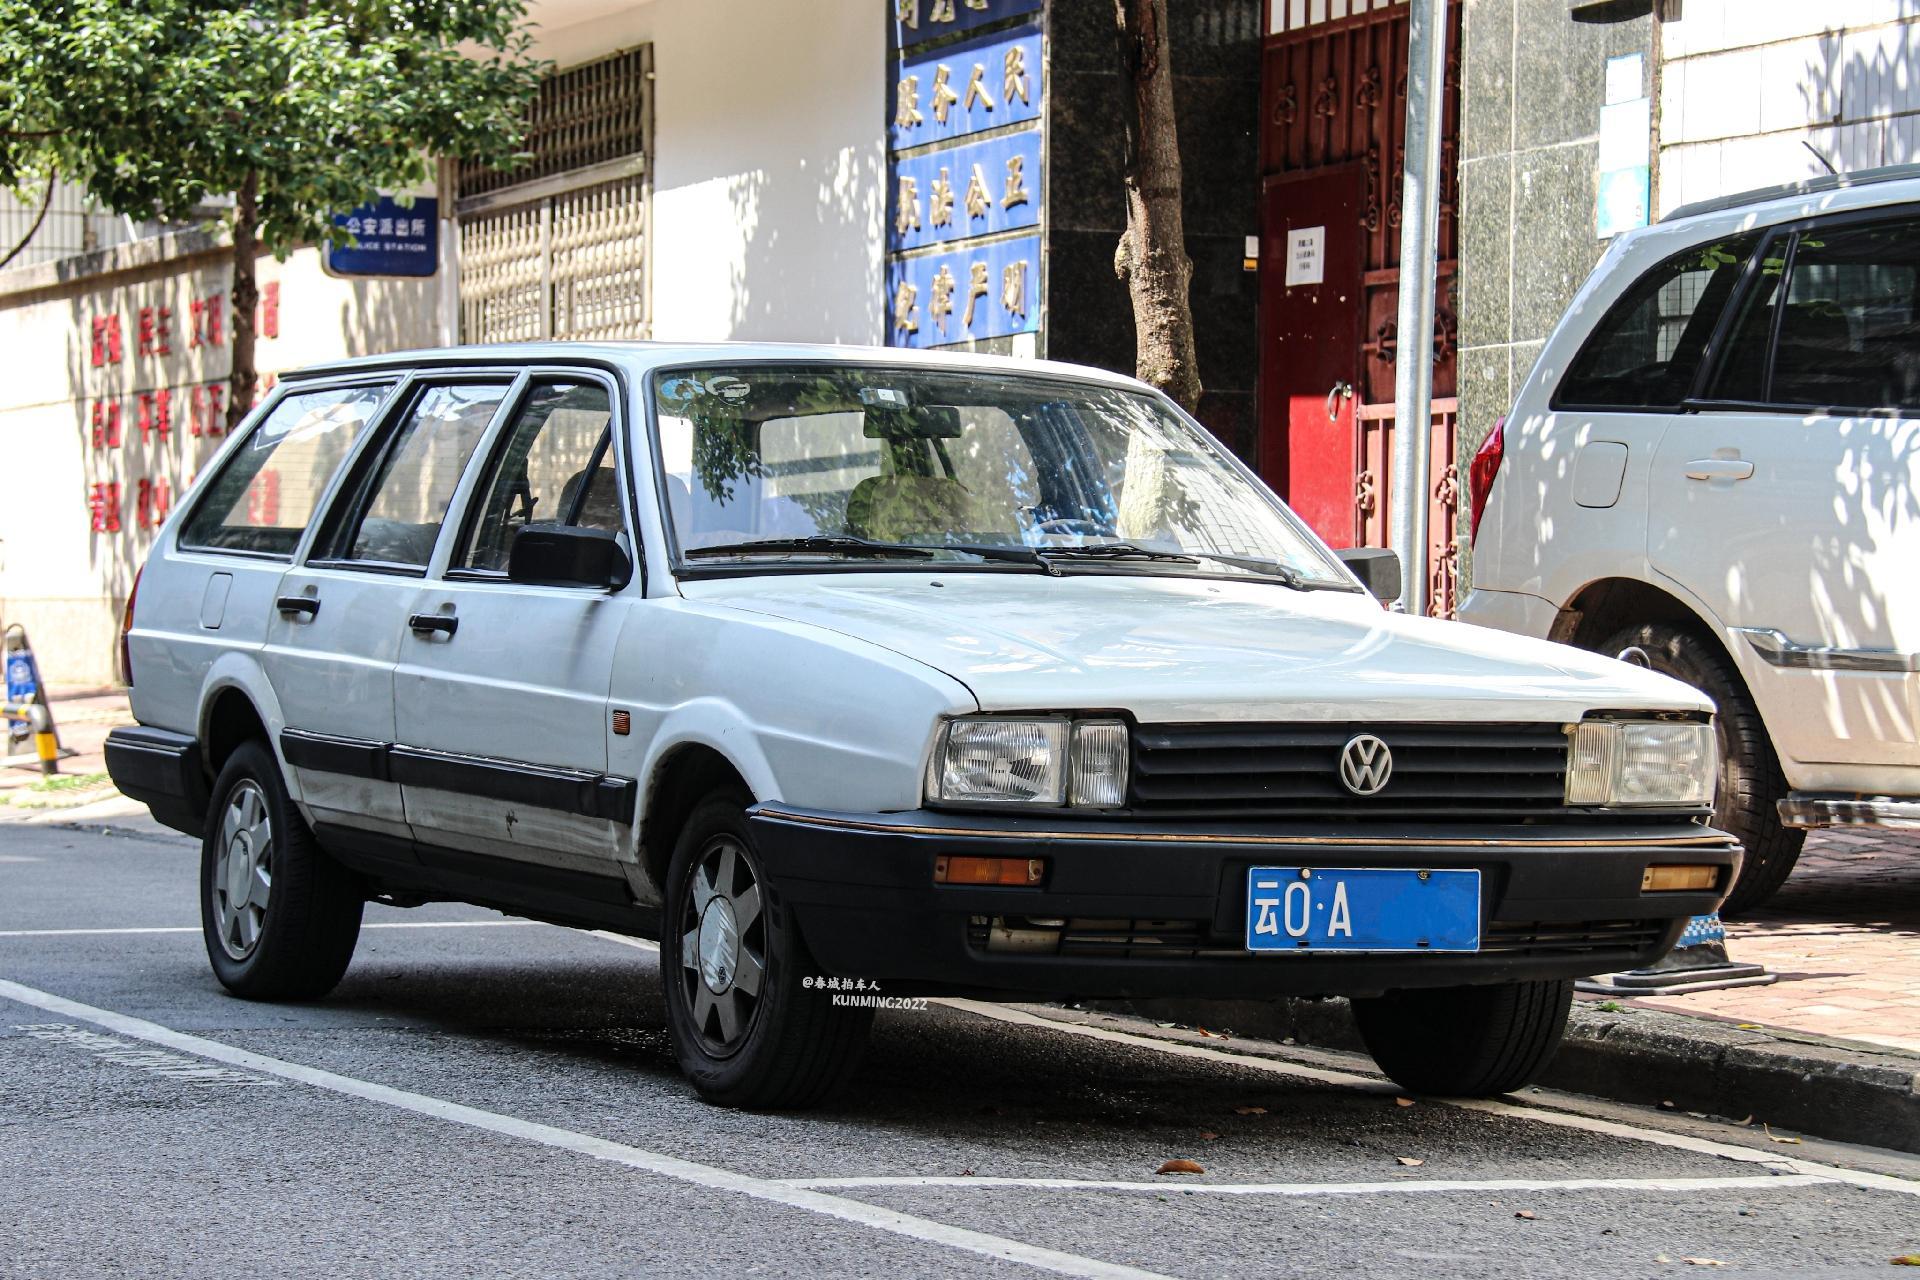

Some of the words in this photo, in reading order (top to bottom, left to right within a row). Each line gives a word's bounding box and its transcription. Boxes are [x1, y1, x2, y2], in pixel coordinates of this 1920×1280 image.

[346, 217, 425, 237] 公安派出所
[383, 242, 427, 252] STATION
